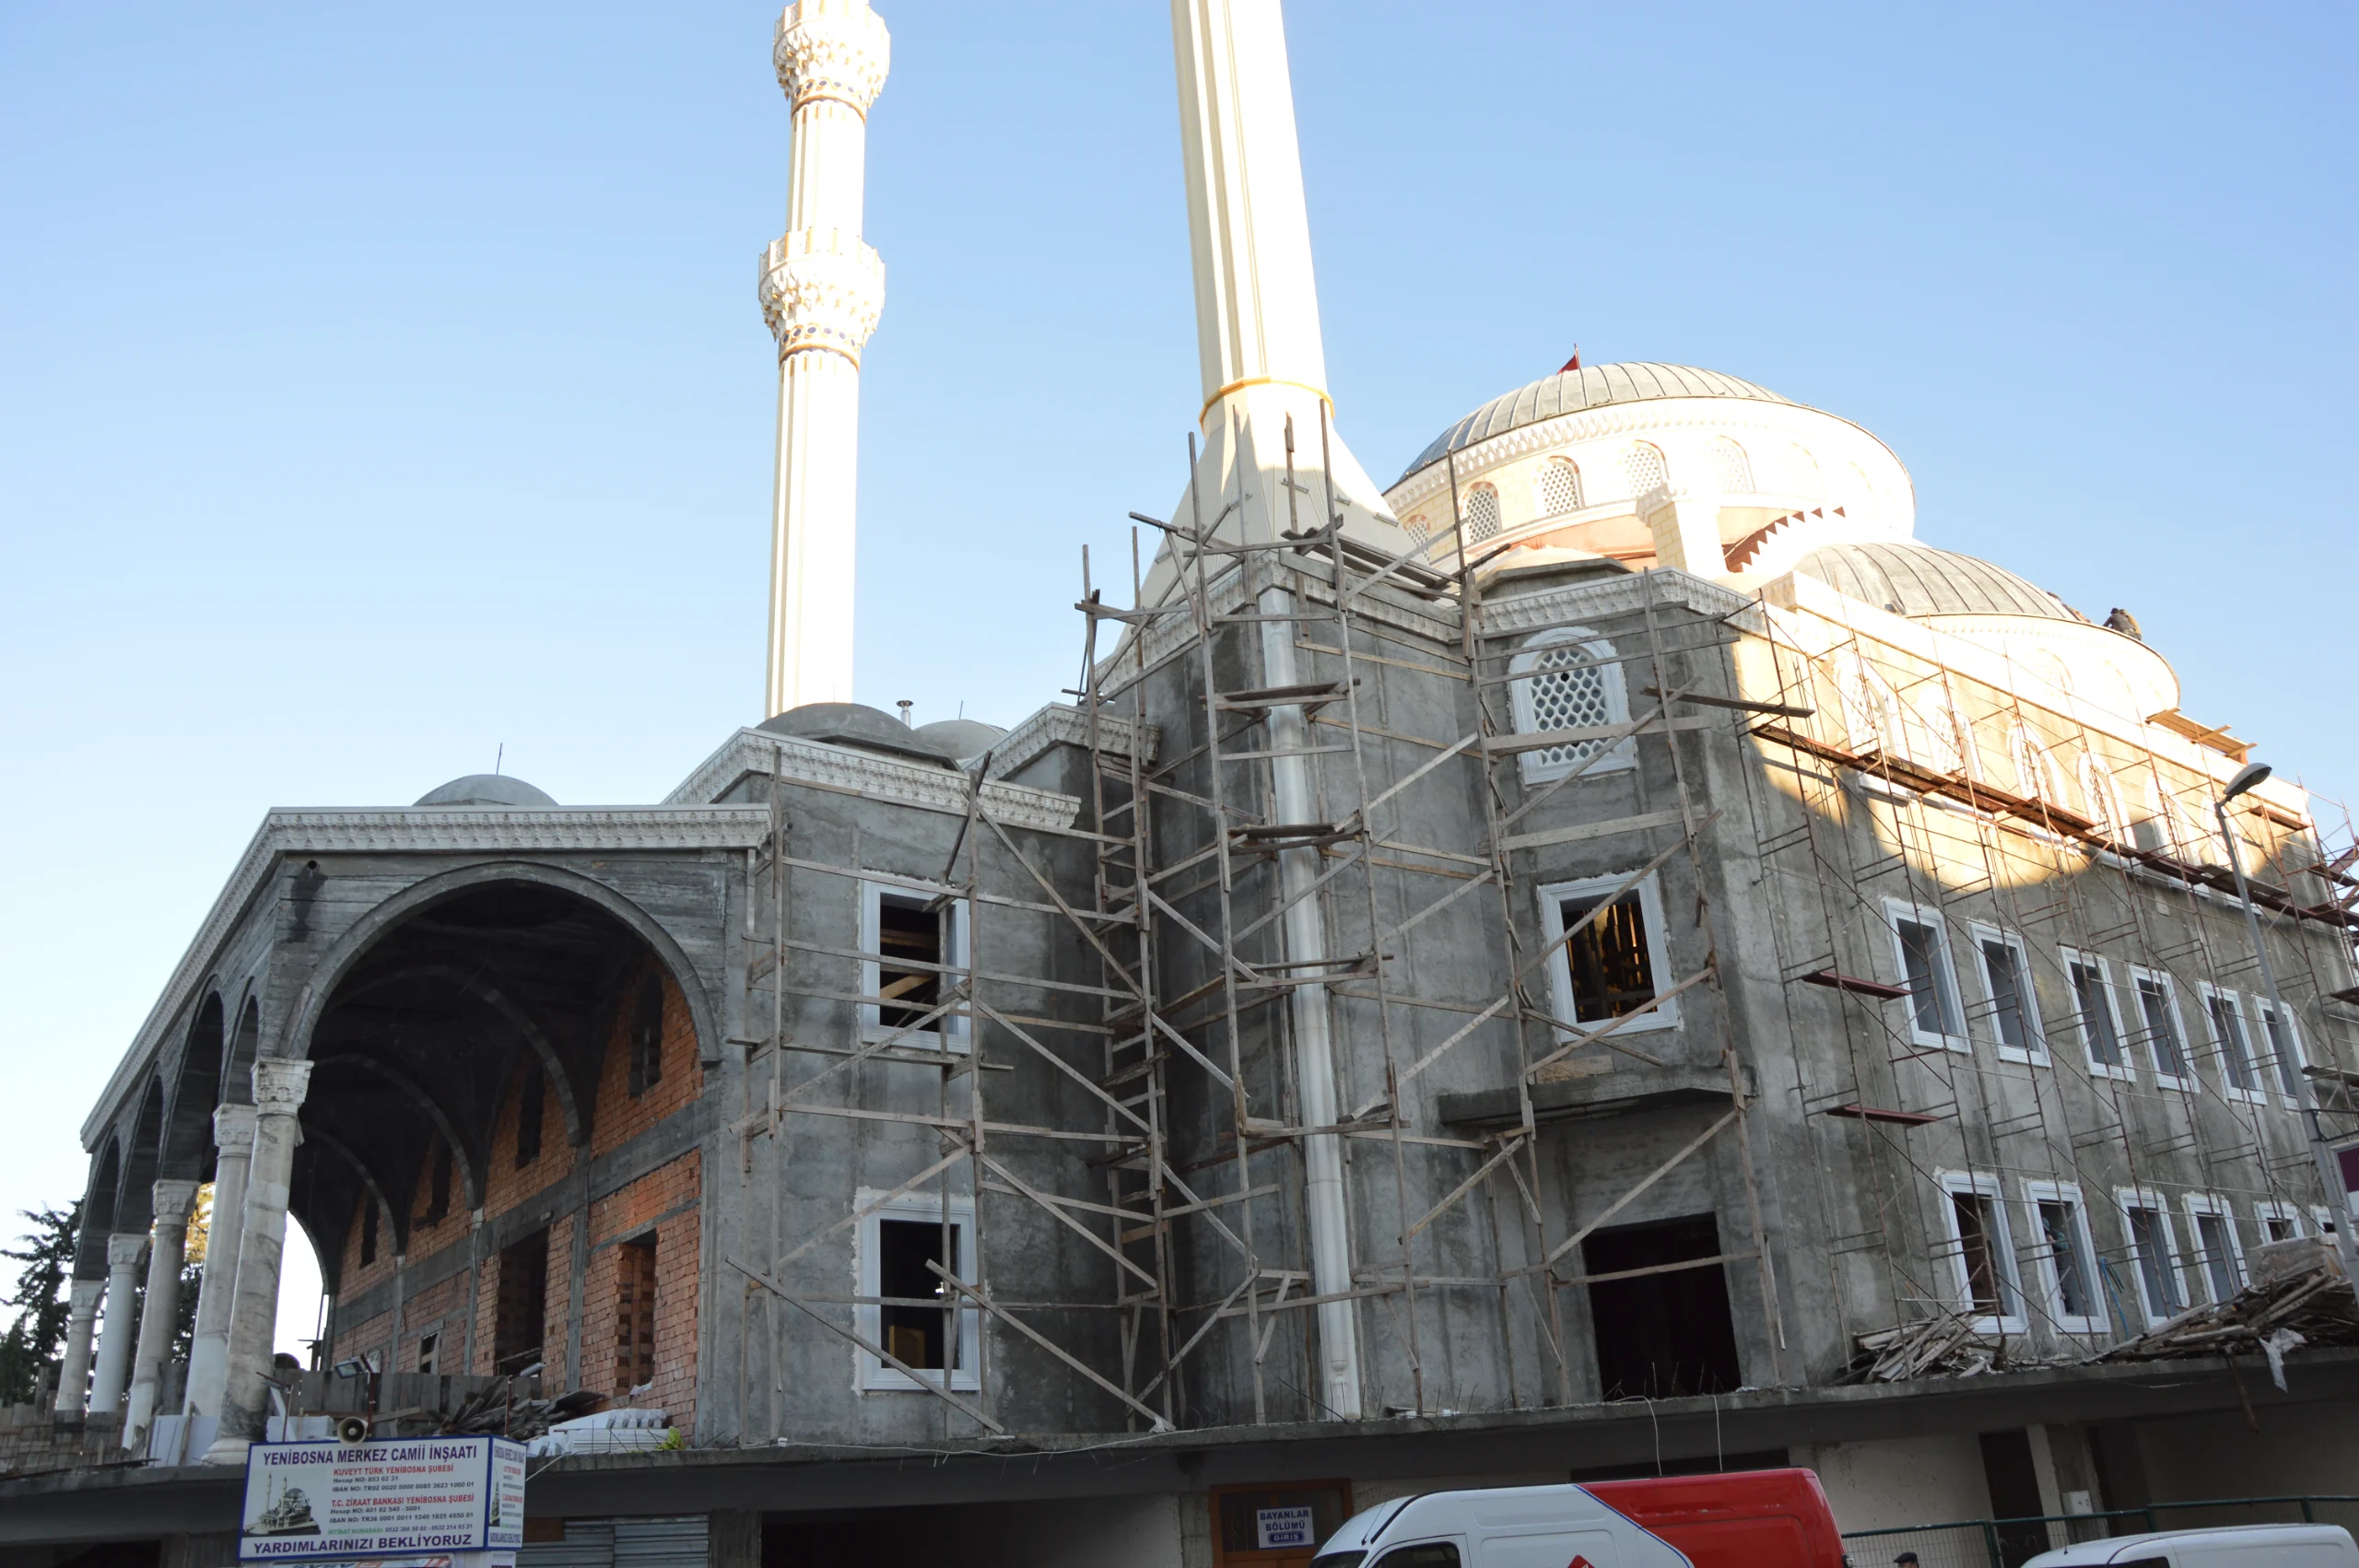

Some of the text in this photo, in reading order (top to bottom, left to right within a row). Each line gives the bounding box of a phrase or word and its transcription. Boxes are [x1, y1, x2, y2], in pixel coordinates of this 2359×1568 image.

[264, 1448, 333, 1466] YENİBOSNA
[337, 1449, 387, 1463] MERKEZ
[391, 1444, 426, 1461] CAMİİ
[429, 1444, 477, 1462] İNŞAATI
[334, 1463, 454, 1476] KUVEYT TÜRK YENİBOSNA ŞUBESİ
[332, 1493, 474, 1507] T.C. ZİRAAT BANKASI YENİBOSNA ŞUBESİ
[1260, 1510, 1309, 1520] BAYANLAR
[1266, 1520, 1305, 1531] BÖLÜMÜ
[254, 1538, 373, 1554] YARDIMLARINIZI
[378, 1534, 472, 1549] BEKLİYORUZ
